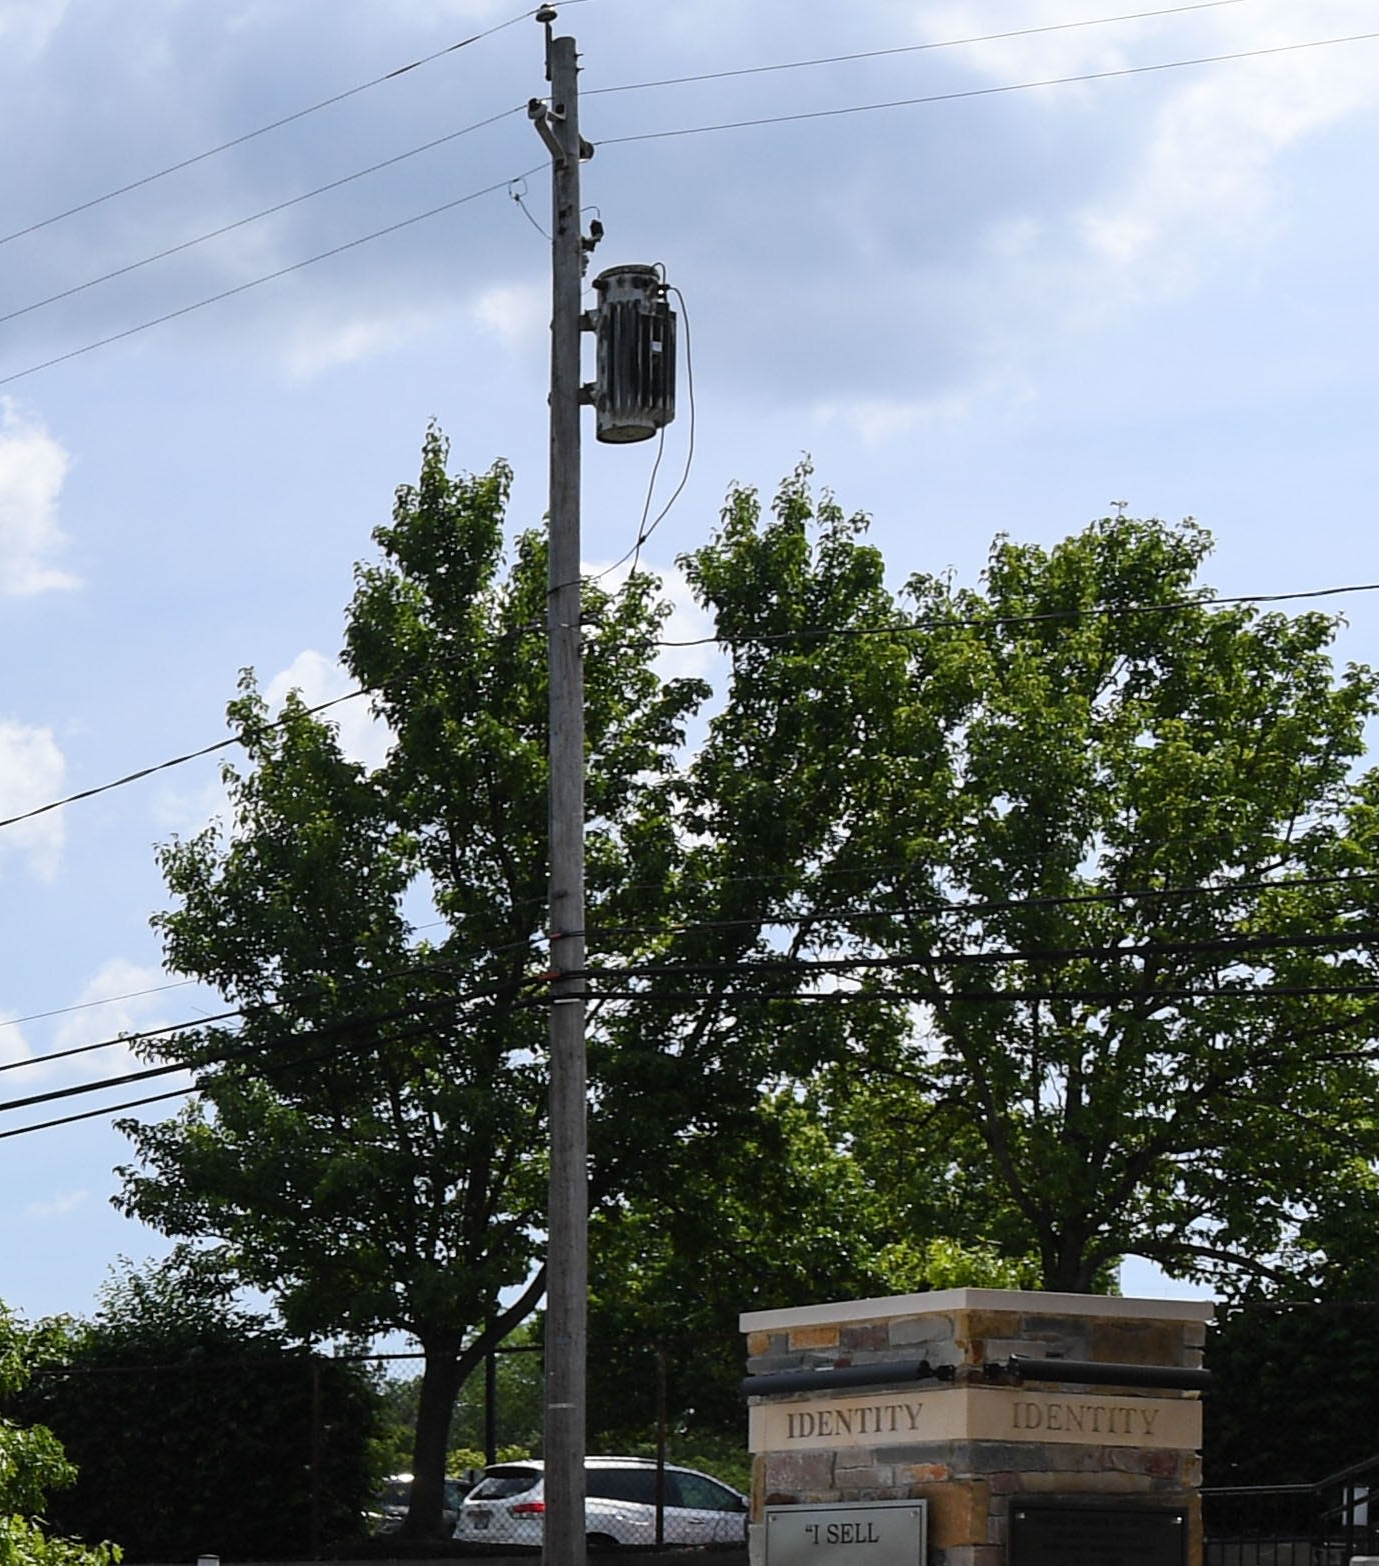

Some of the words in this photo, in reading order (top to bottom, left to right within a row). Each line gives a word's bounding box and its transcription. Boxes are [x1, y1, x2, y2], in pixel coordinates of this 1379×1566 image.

[786, 1403, 924, 1440] IDENTITY
[1011, 1401, 1160, 1437] IDENTITY
[826, 1522, 880, 1544] SELL
